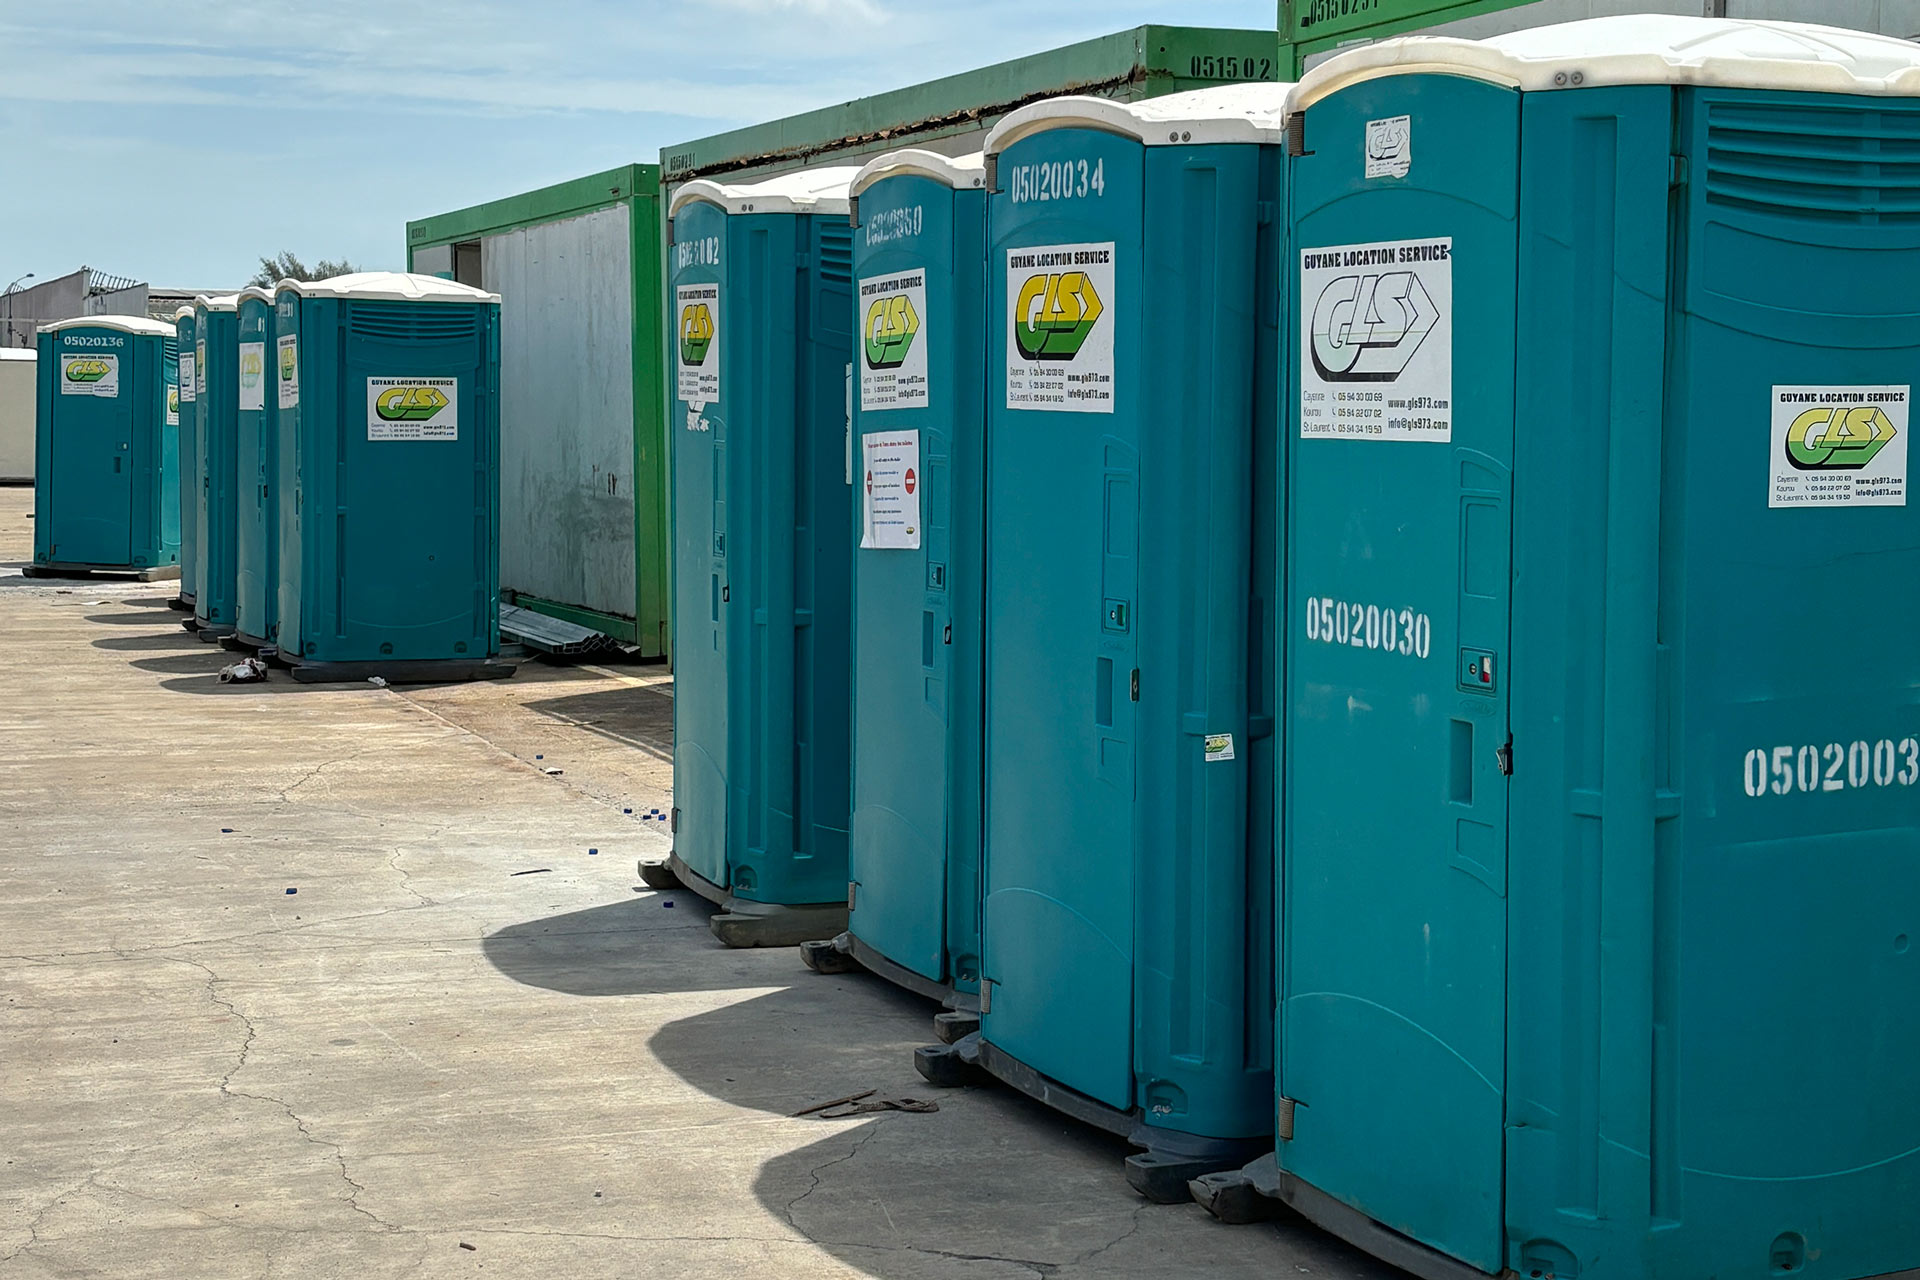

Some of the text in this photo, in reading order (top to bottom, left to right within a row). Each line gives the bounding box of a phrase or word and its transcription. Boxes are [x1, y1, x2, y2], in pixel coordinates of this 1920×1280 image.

[1190, 56, 1278, 80] 051502
[1012, 157, 1104, 204] 05020034
[1011, 250, 1109, 269] GUYANE LOCATION SERVICE
[1304, 244, 1448, 269] GUYANE LOCATION SERVICE
[878, 279, 899, 293] LOCATION
[900, 276, 922, 289] SERVICE
[1015, 271, 1098, 360] GLS
[1311, 272, 1428, 382] GLS
[64, 336, 124, 347] 05020136
[865, 294, 917, 370] GLS
[376, 388, 444, 421] GLS
[1388, 397, 1448, 410] www.gls973.com
[1780, 392, 1905, 402] GUYANE LOCATION SERVICE
[1388, 417, 1448, 431] info@gls973.com
[1786, 407, 1886, 470] GLS
[1306, 596, 1430, 659] 05020030
[1744, 738, 1919, 797] 0502003
